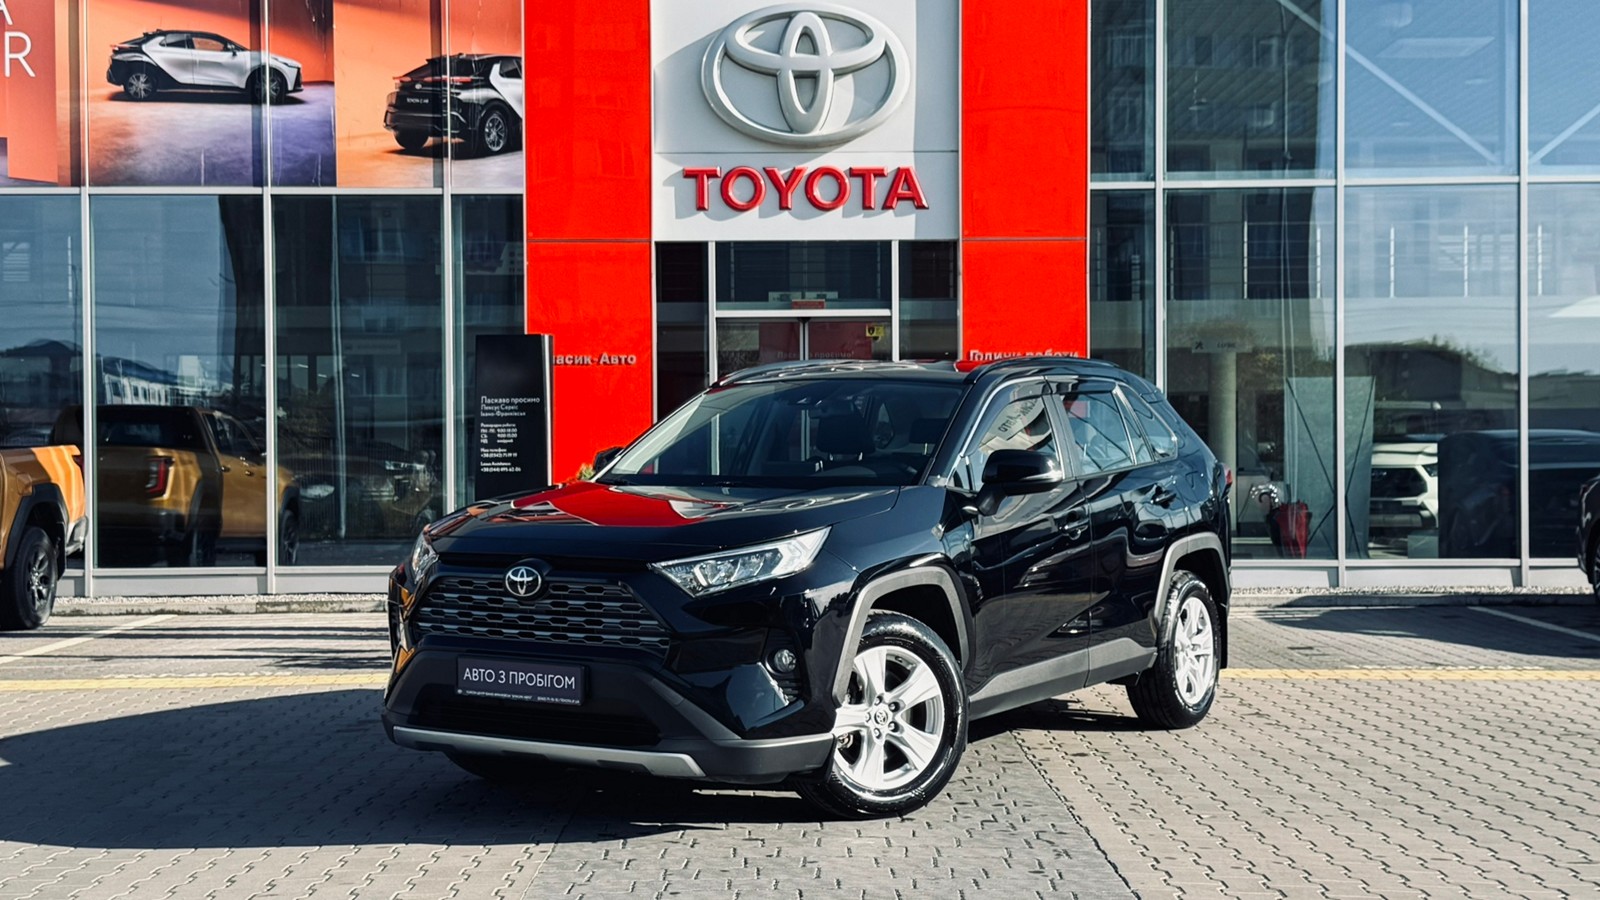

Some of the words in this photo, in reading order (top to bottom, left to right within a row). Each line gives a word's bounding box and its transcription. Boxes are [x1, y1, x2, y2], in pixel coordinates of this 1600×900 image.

[683, 166, 929, 211] TOYOTA
[553, 352, 637, 365] асик-Авто
[511, 397, 540, 405] просимо
[463, 667, 496, 683] АВТО
[498, 670, 506, 684] З
[509, 671, 576, 690] ПРОБІГОМ
